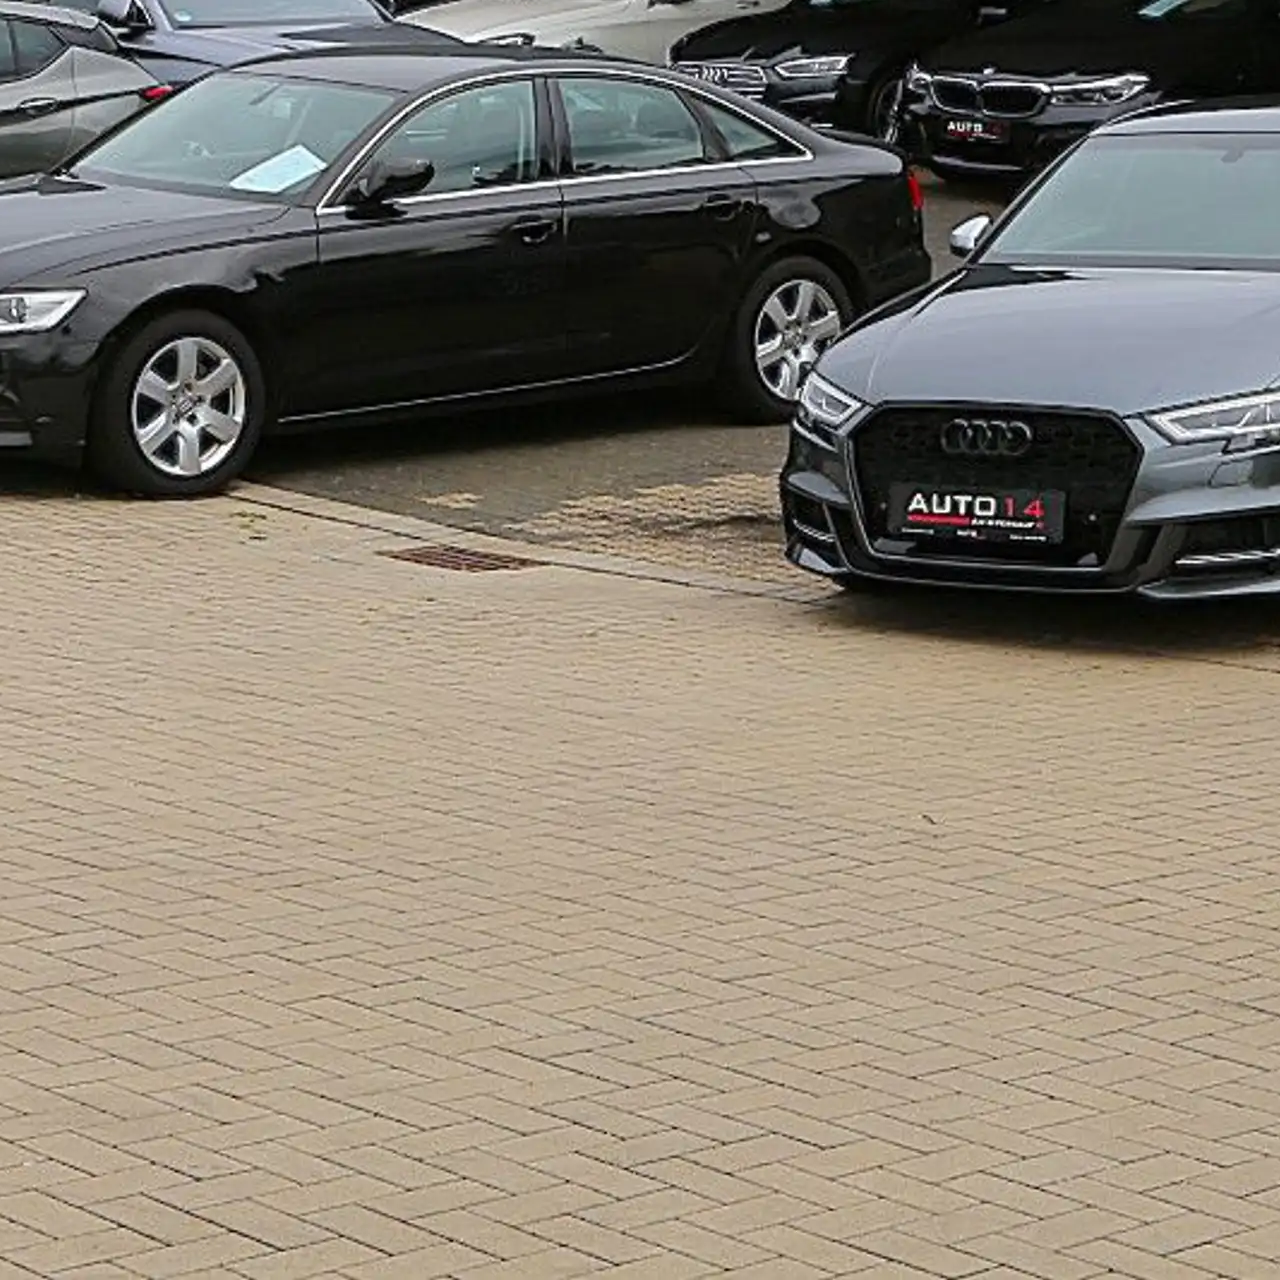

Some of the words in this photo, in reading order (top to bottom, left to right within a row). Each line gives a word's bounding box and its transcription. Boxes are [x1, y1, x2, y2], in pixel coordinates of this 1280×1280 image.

[947, 120, 983, 133] AUTO
[907, 492, 997, 517] AUTO
[1004, 496, 1045, 519] 14
